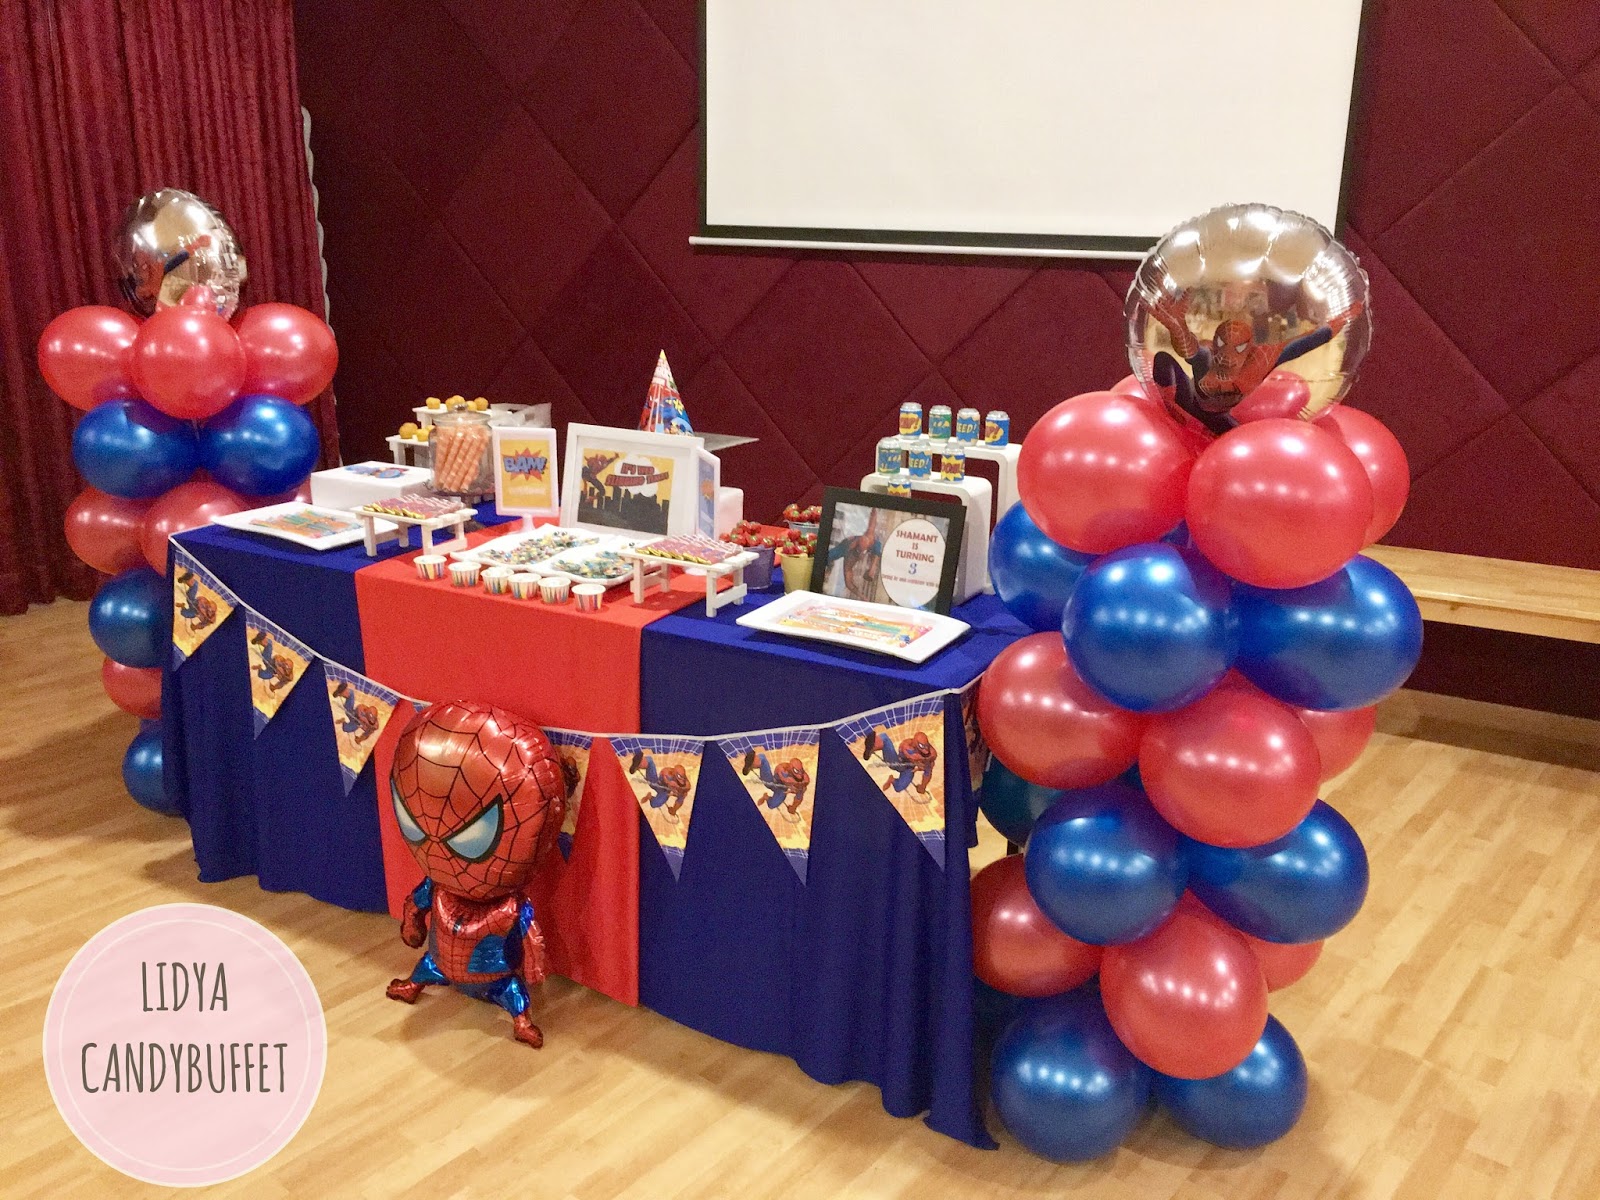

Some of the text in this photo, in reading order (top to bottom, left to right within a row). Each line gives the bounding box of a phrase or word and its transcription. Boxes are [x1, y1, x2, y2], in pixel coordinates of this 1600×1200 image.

[503, 455, 548, 475] BAM!
[896, 530, 939, 543] SHAMANT
[911, 542, 919, 550] IS
[896, 549, 935, 563] TURNING
[908, 562, 917, 575] 3
